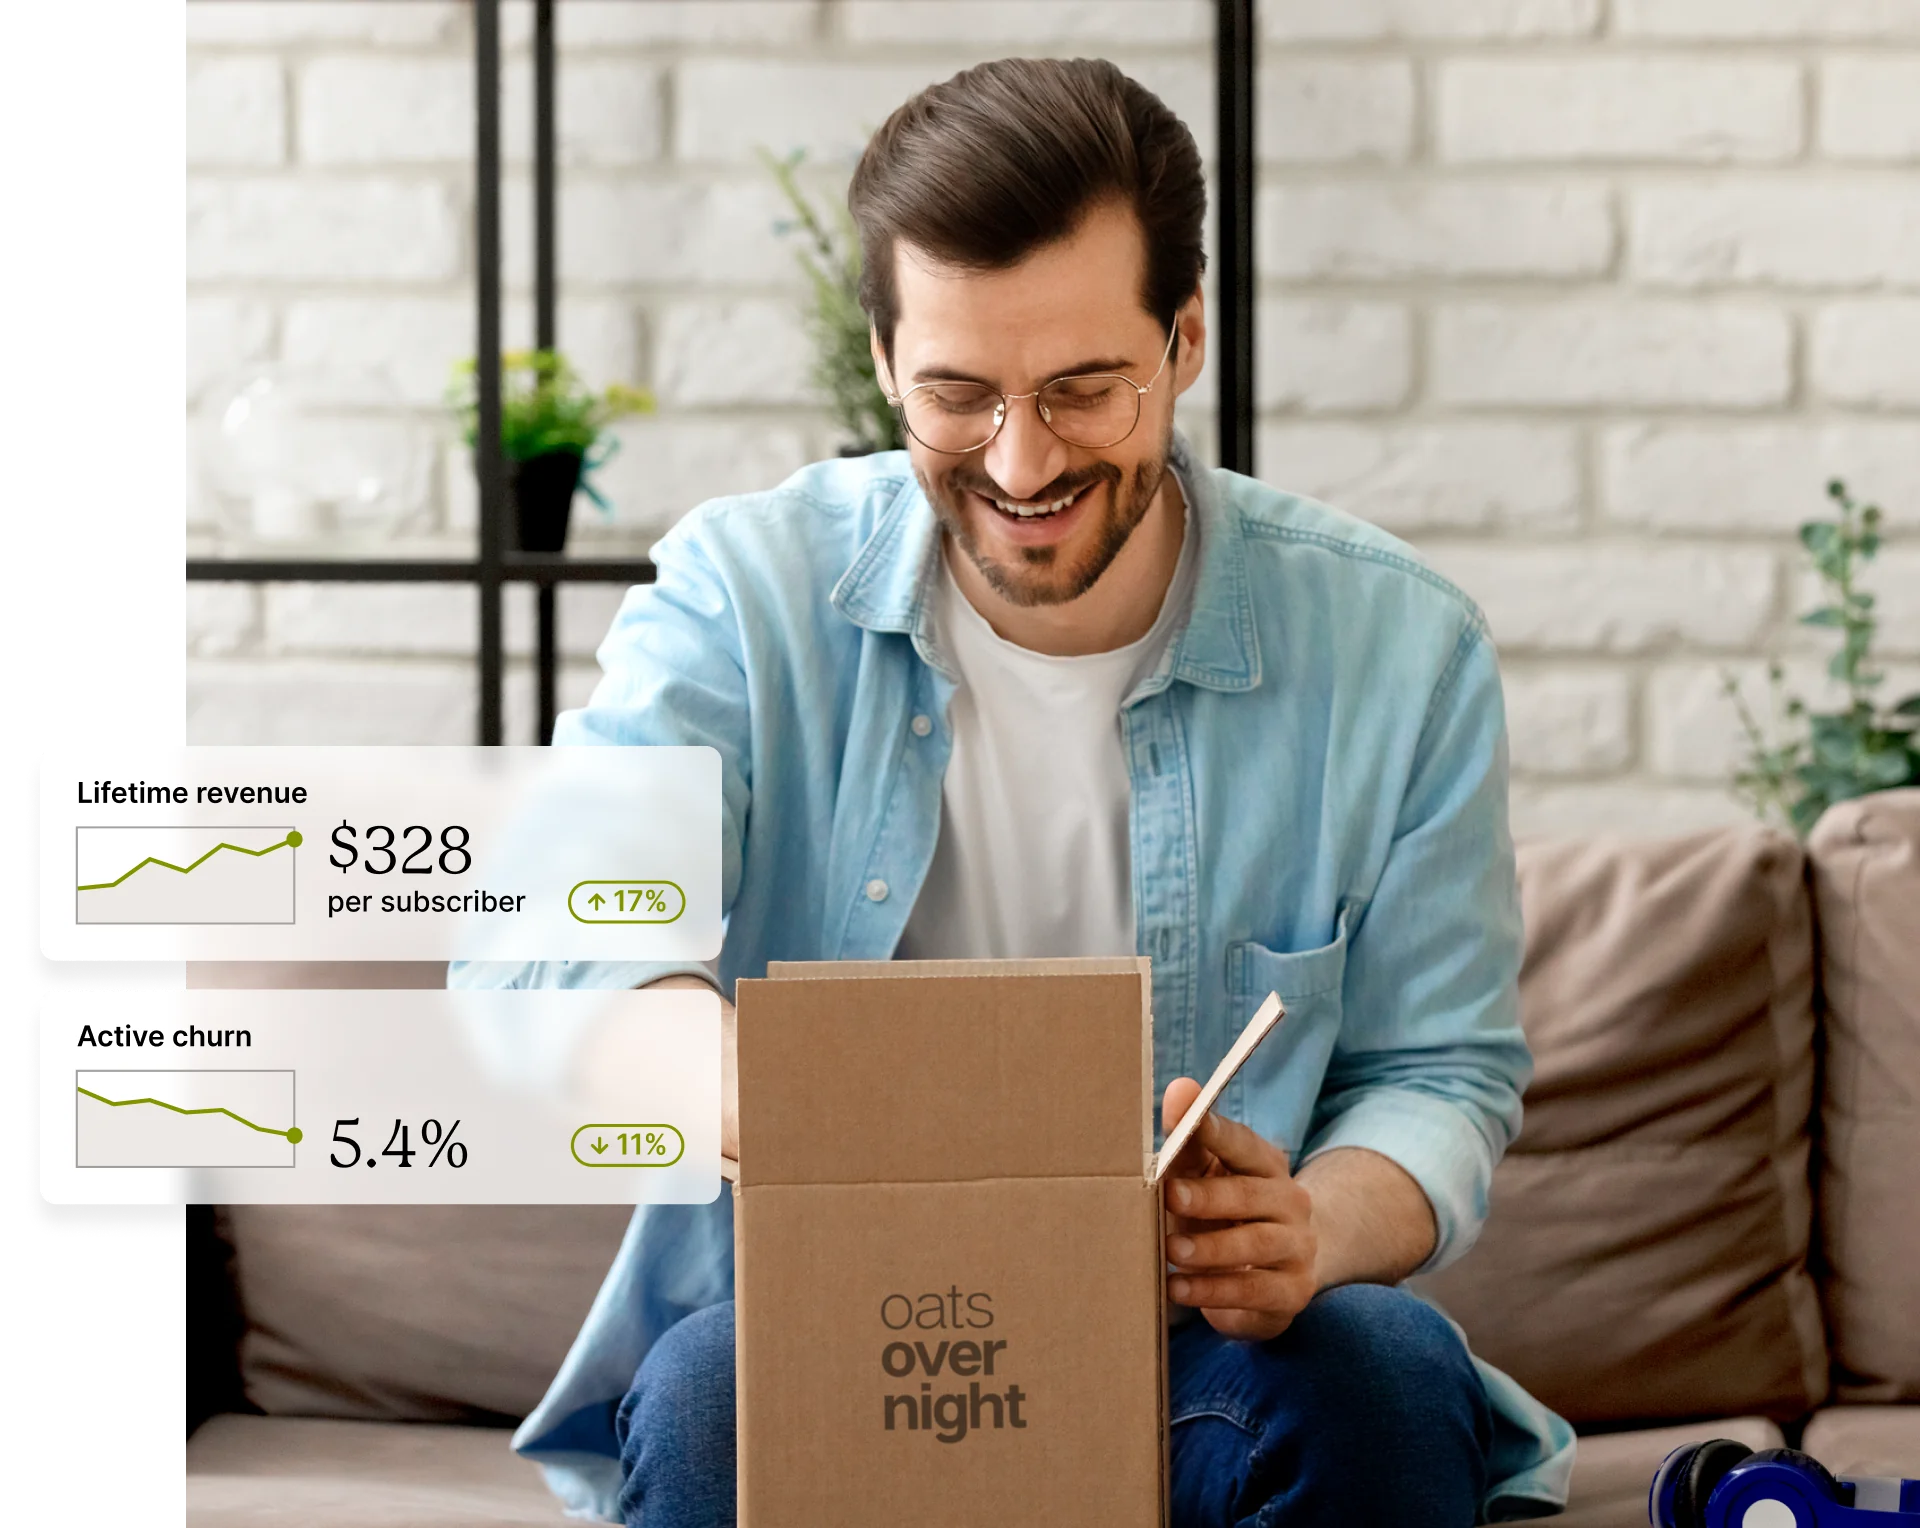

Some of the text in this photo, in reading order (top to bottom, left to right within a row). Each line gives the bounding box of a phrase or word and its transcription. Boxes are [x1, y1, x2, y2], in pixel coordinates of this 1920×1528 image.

[880, 1284, 994, 1331] oats
[881, 1339, 1008, 1378] over
[883, 1381, 1028, 1445] night
